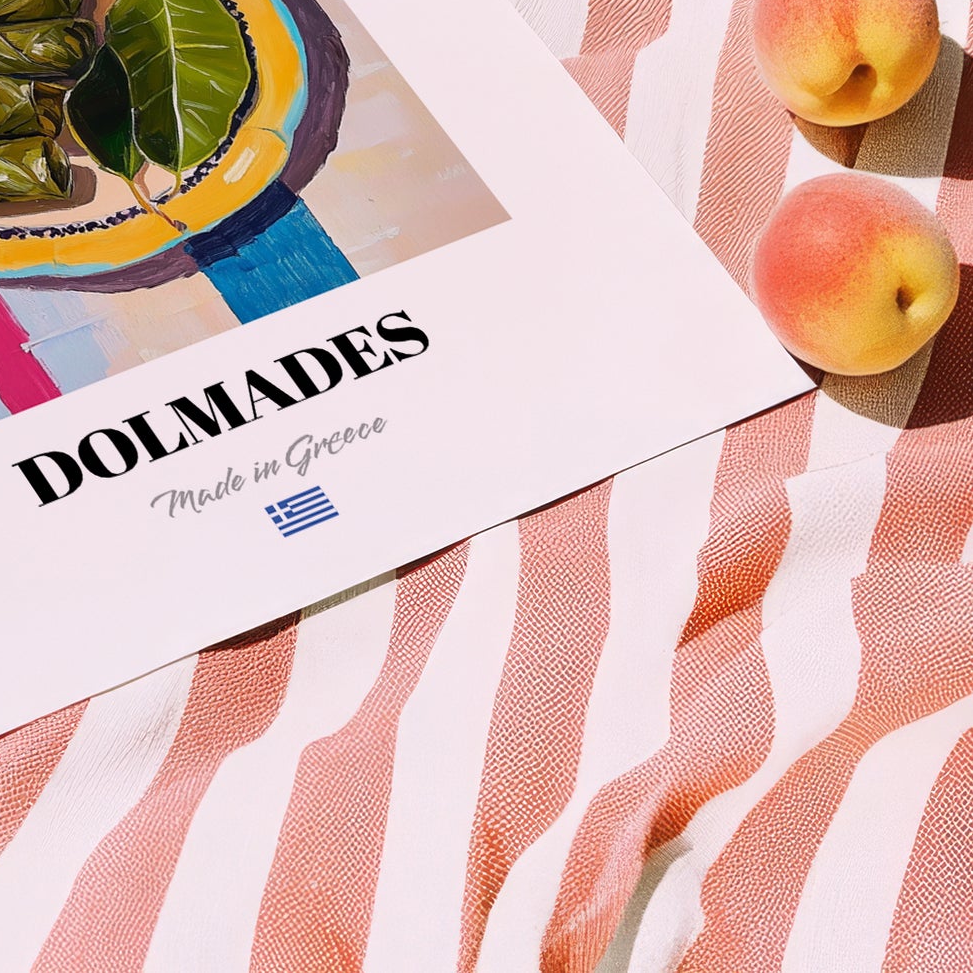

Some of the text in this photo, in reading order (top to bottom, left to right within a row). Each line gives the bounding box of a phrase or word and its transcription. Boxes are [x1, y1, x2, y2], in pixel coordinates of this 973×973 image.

[11, 309, 430, 508] DOLMADES
[150, 416, 388, 519] Made in Greece
